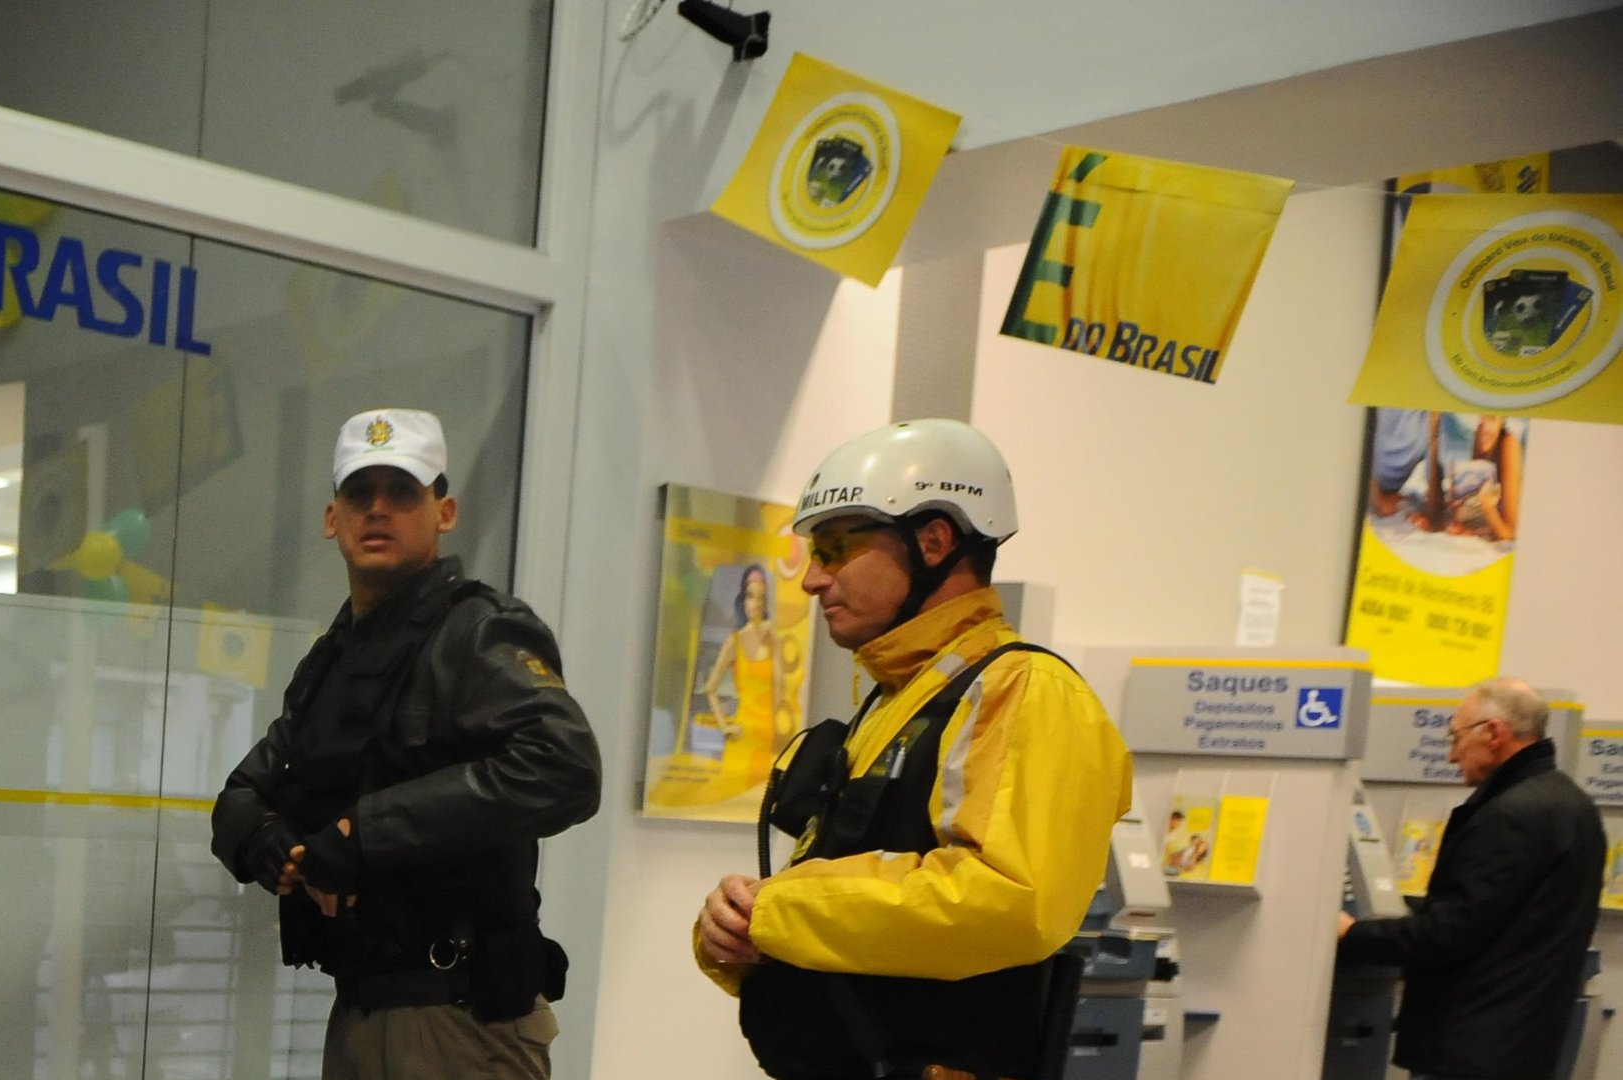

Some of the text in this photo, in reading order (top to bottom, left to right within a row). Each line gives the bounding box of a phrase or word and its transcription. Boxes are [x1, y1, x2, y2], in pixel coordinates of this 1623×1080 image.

[1107, 320, 1221, 385] BRASIL
[940, 481, 983, 497] BPM
[1187, 670, 1289, 696] Saques
[1194, 700, 1275, 715] Depósitos
[1183, 716, 1284, 731] Pagamentos
[1198, 735, 1266, 749] Extratos
